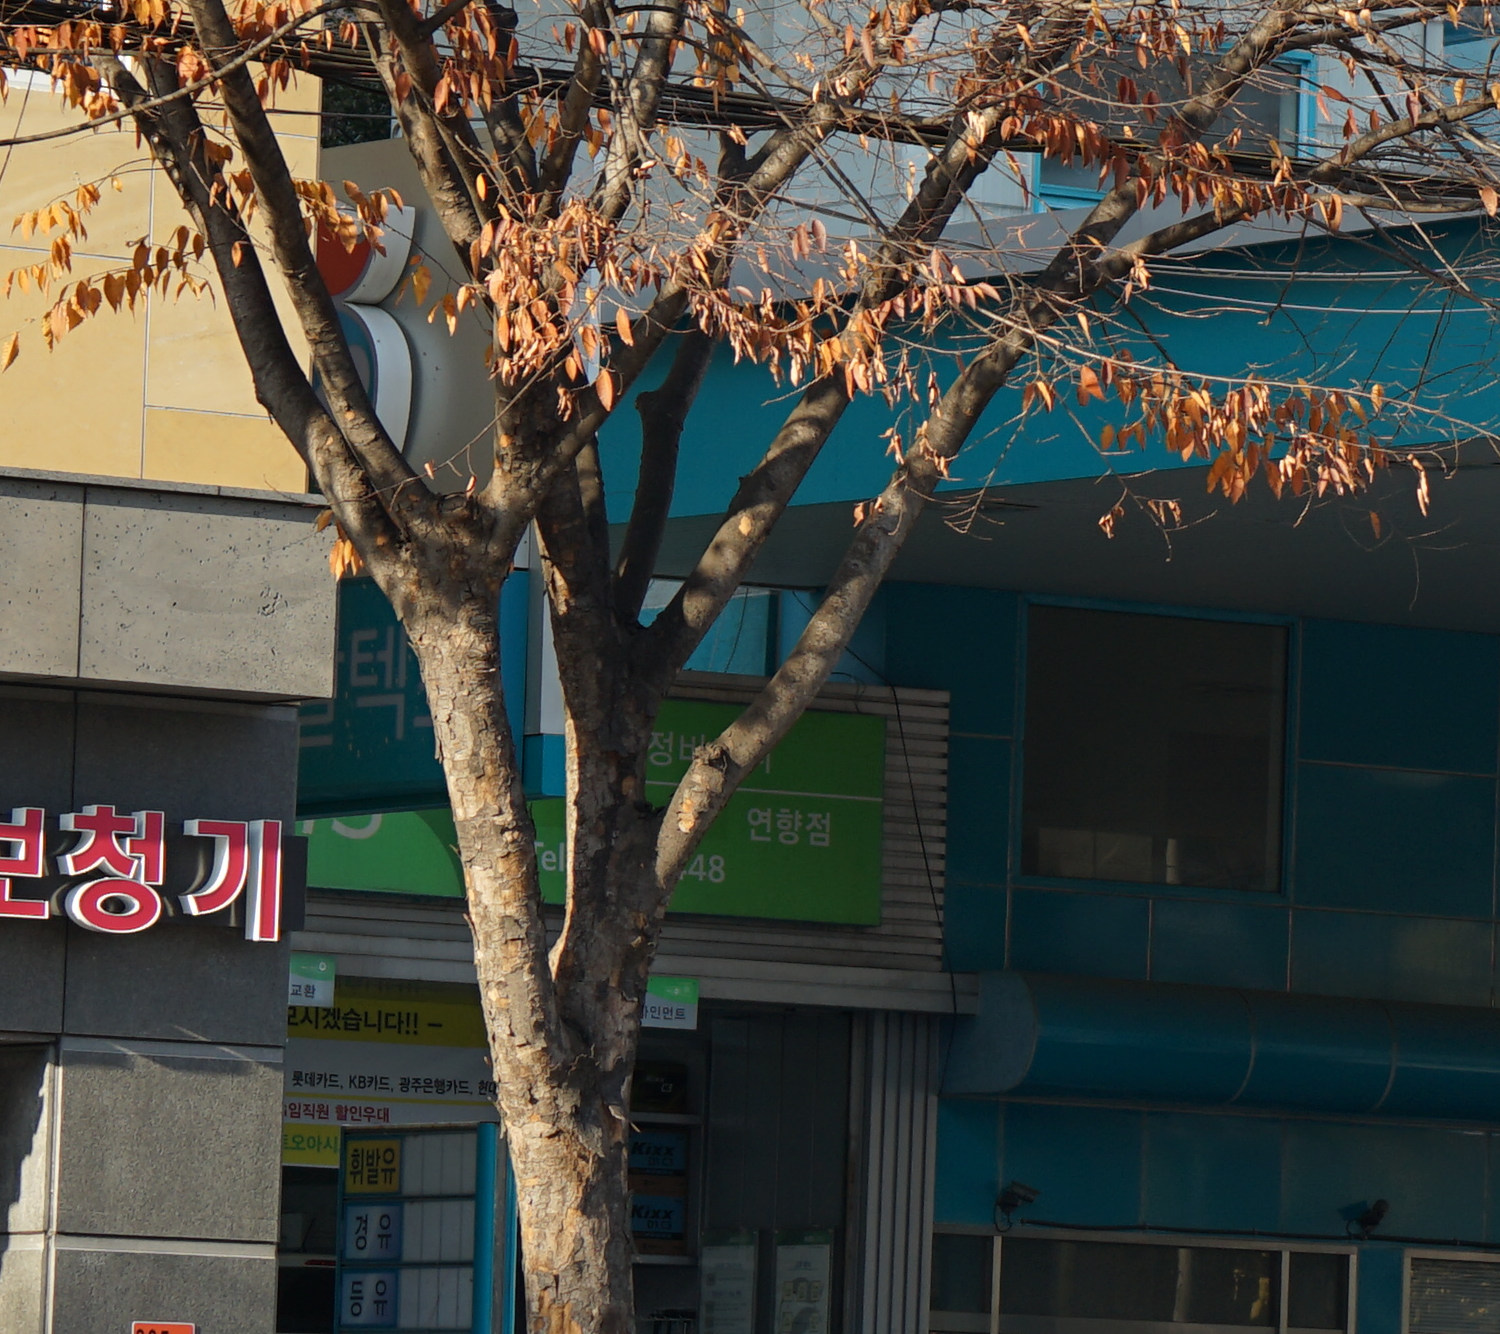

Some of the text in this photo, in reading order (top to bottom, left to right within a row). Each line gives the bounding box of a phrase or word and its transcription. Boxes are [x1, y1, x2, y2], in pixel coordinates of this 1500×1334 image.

[748, 807, 831, 848] 연향점
[335, 1103, 391, 1123] 할인우대
[350, 1148, 396, 1187] 휘발유
[353, 1213, 395, 1251] 경유
[349, 1281, 389, 1318] 등유
